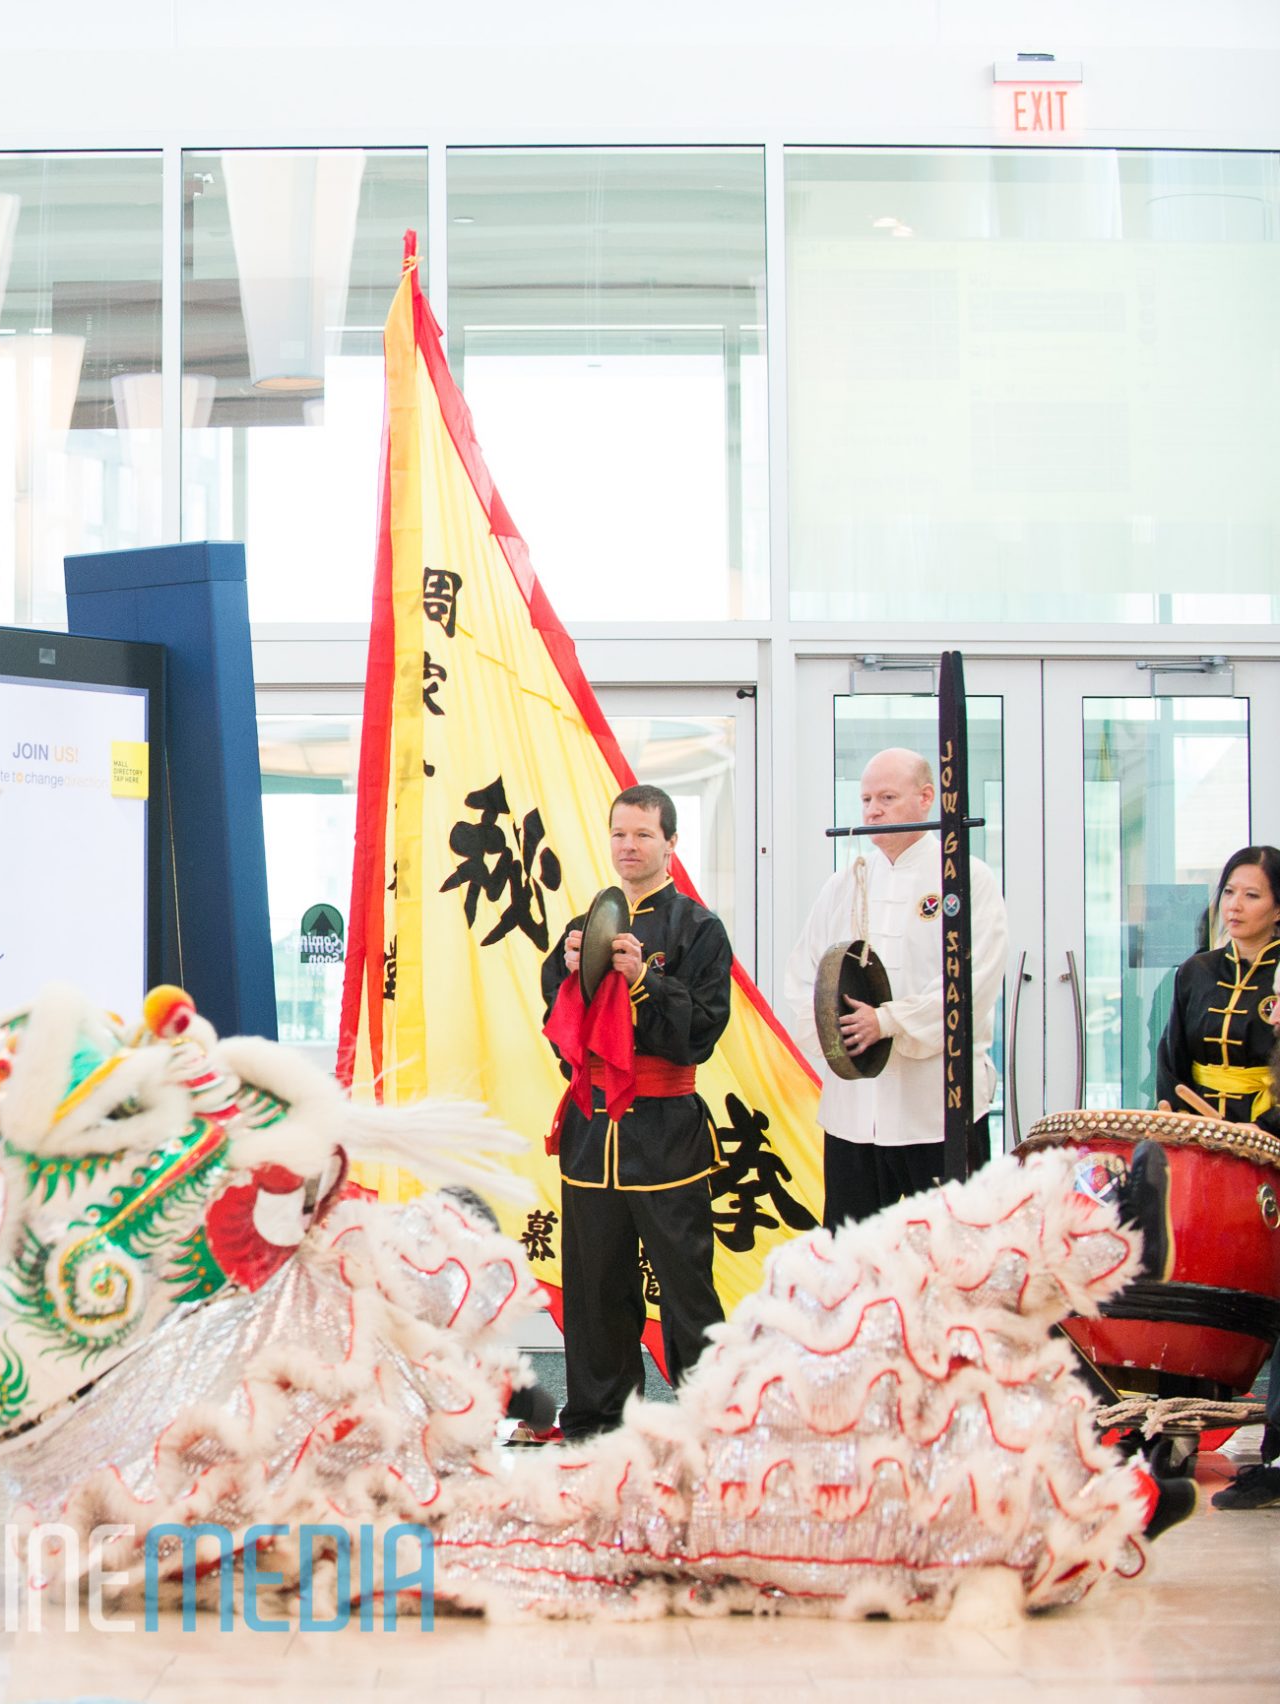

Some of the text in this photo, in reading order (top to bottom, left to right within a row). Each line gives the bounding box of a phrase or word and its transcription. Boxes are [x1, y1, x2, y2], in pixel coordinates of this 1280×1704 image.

[1013, 91, 1068, 131] EXIT
[12, 742, 79, 763] JOIN US!
[940, 740, 962, 1109] JOW GA SHAOLIN
